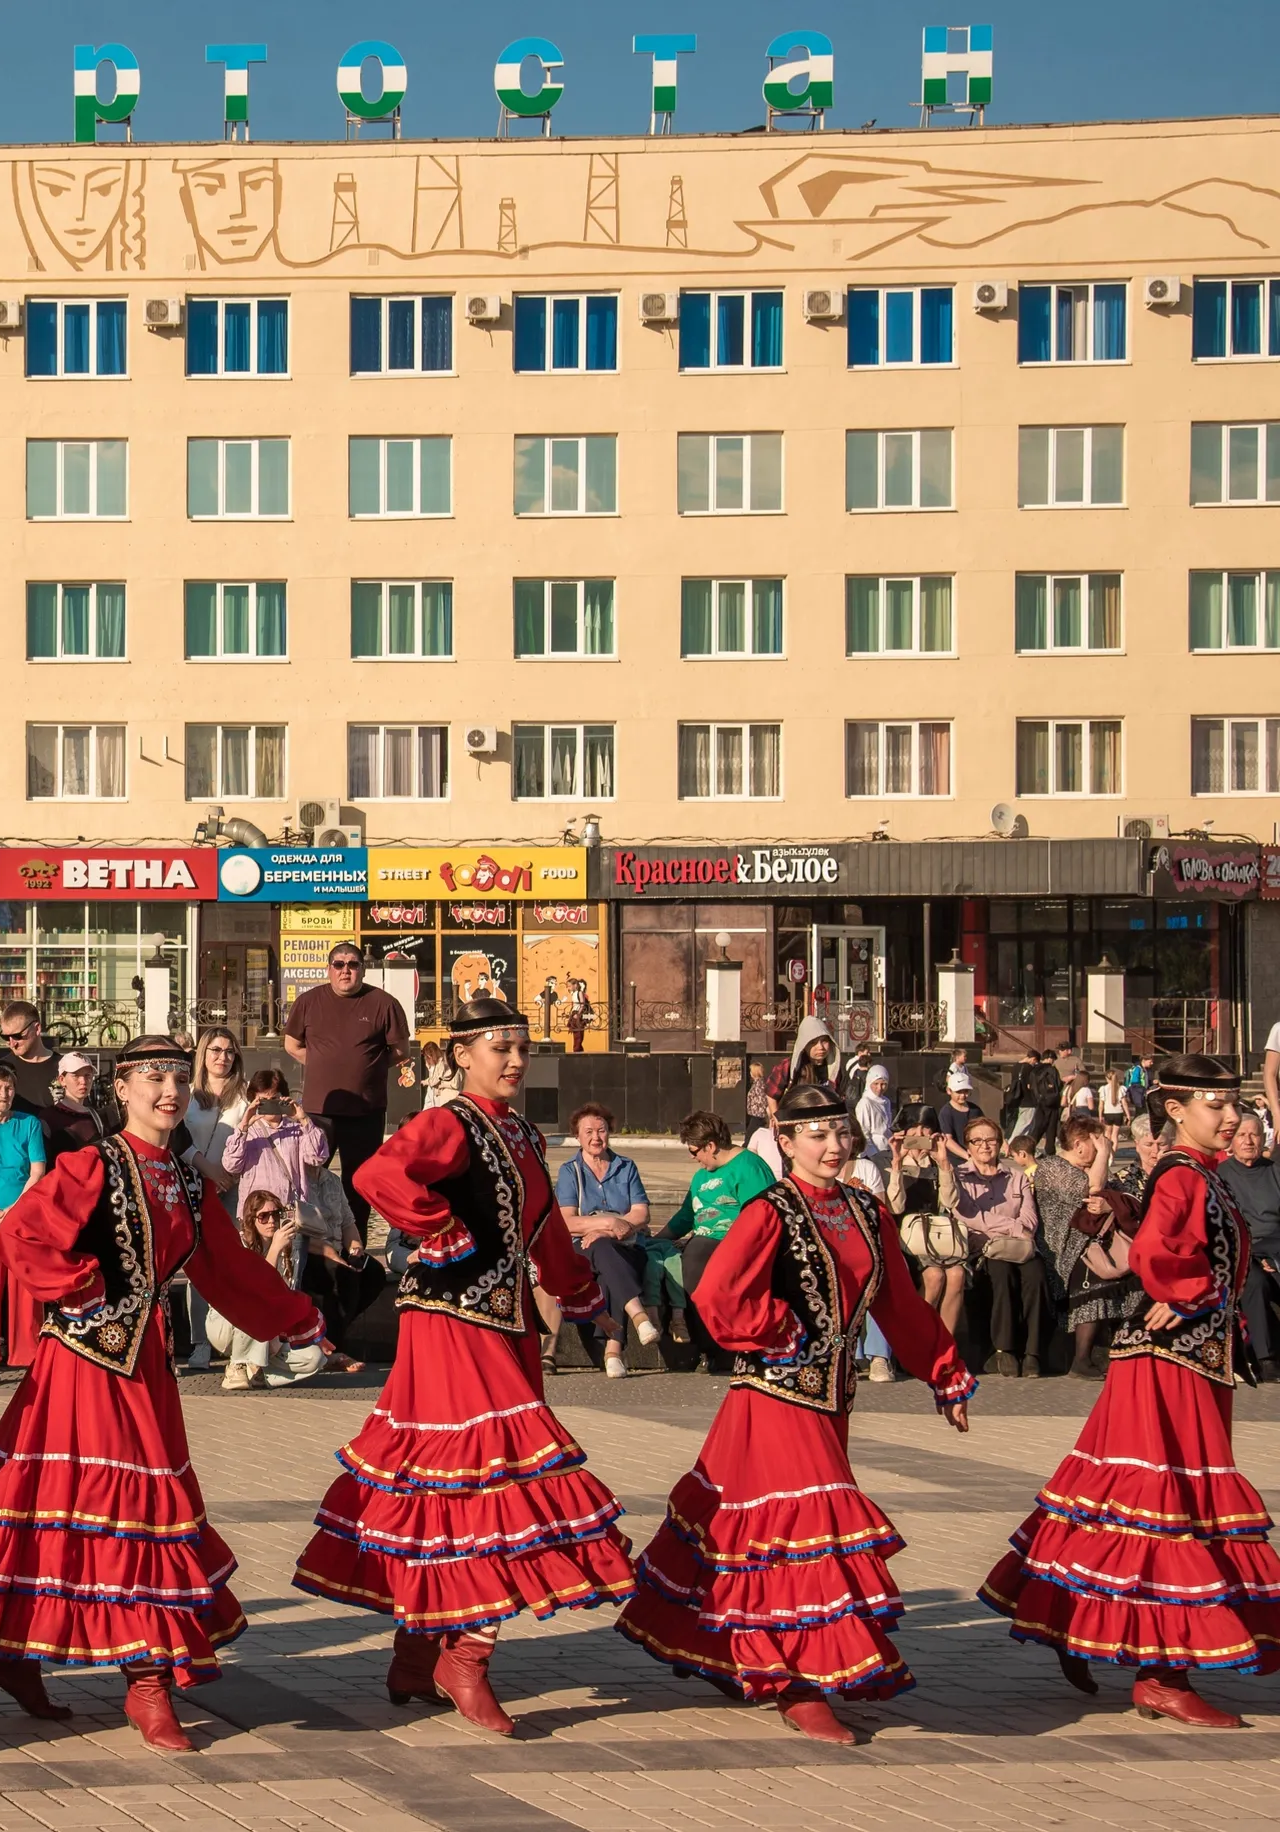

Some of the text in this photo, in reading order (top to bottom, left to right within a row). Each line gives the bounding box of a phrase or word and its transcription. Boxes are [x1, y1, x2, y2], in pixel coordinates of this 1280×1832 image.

[271, 854, 343, 865] ОДЕЖДА ДЛЯ
[62, 859, 196, 888] ВЕТНА
[263, 870, 367, 883] БЕРЕМЕННЫХ
[378, 867, 430, 881] STREET
[539, 867, 577, 880] FOOD
[24, 880, 51, 888] 1992
[321, 885, 366, 893] МАЛЫШЕЙ
[301, 917, 333, 925] БРОВИ
[283, 939, 330, 951] РЕМОНТ
